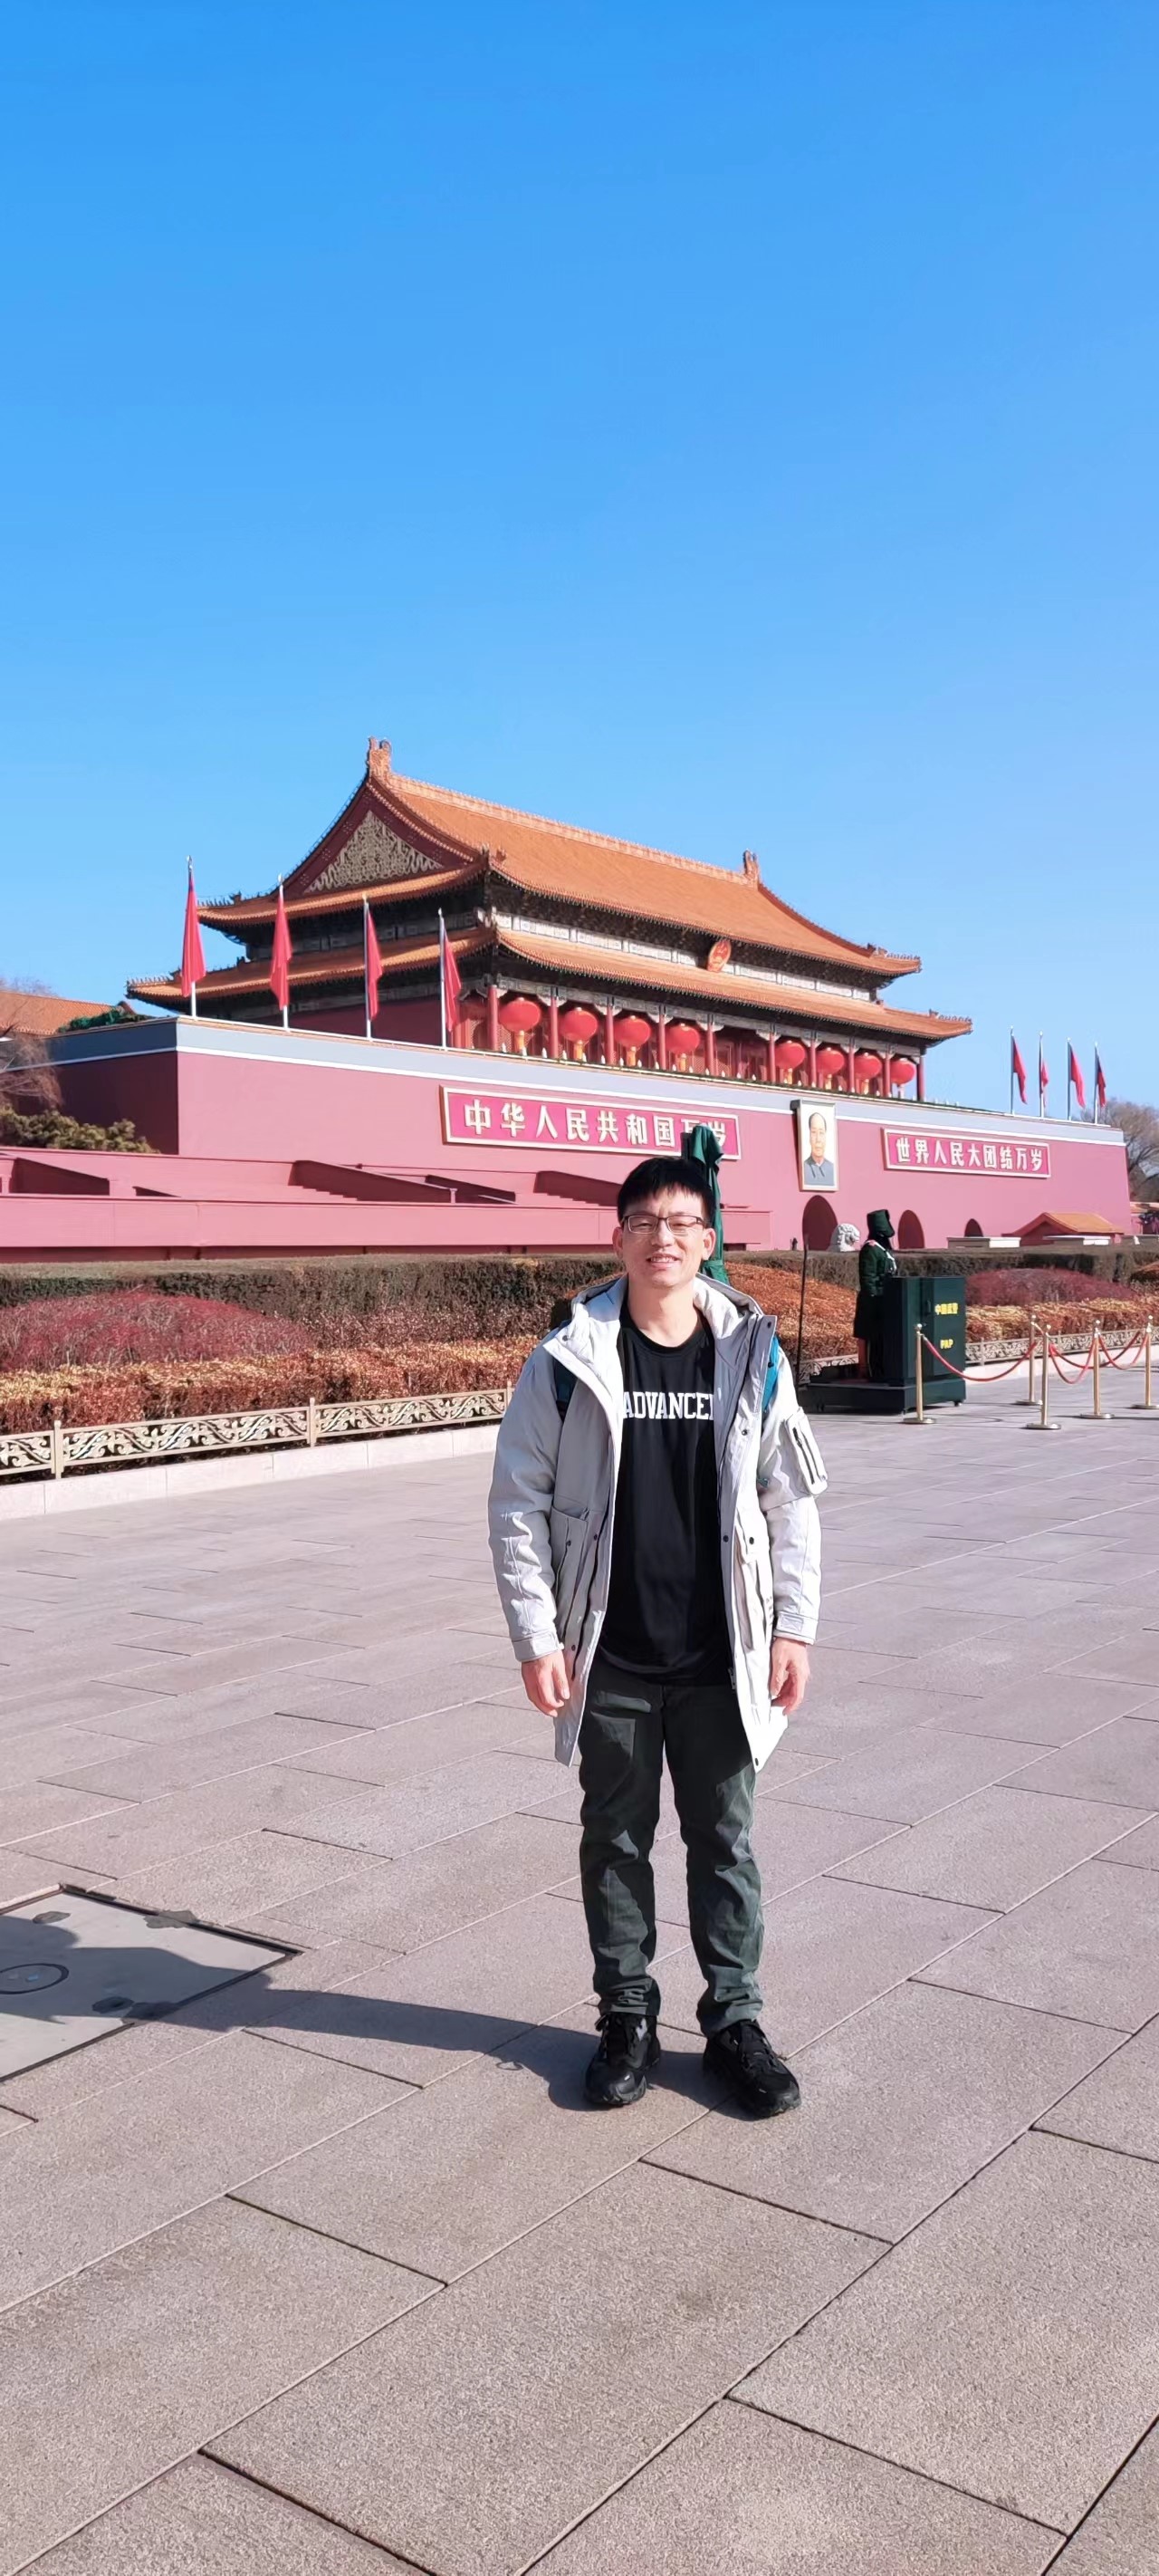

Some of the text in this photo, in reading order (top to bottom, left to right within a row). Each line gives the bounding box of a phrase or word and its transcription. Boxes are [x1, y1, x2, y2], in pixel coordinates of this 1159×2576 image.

[896, 1137, 1043, 1171] 世界人民大团结万岁
